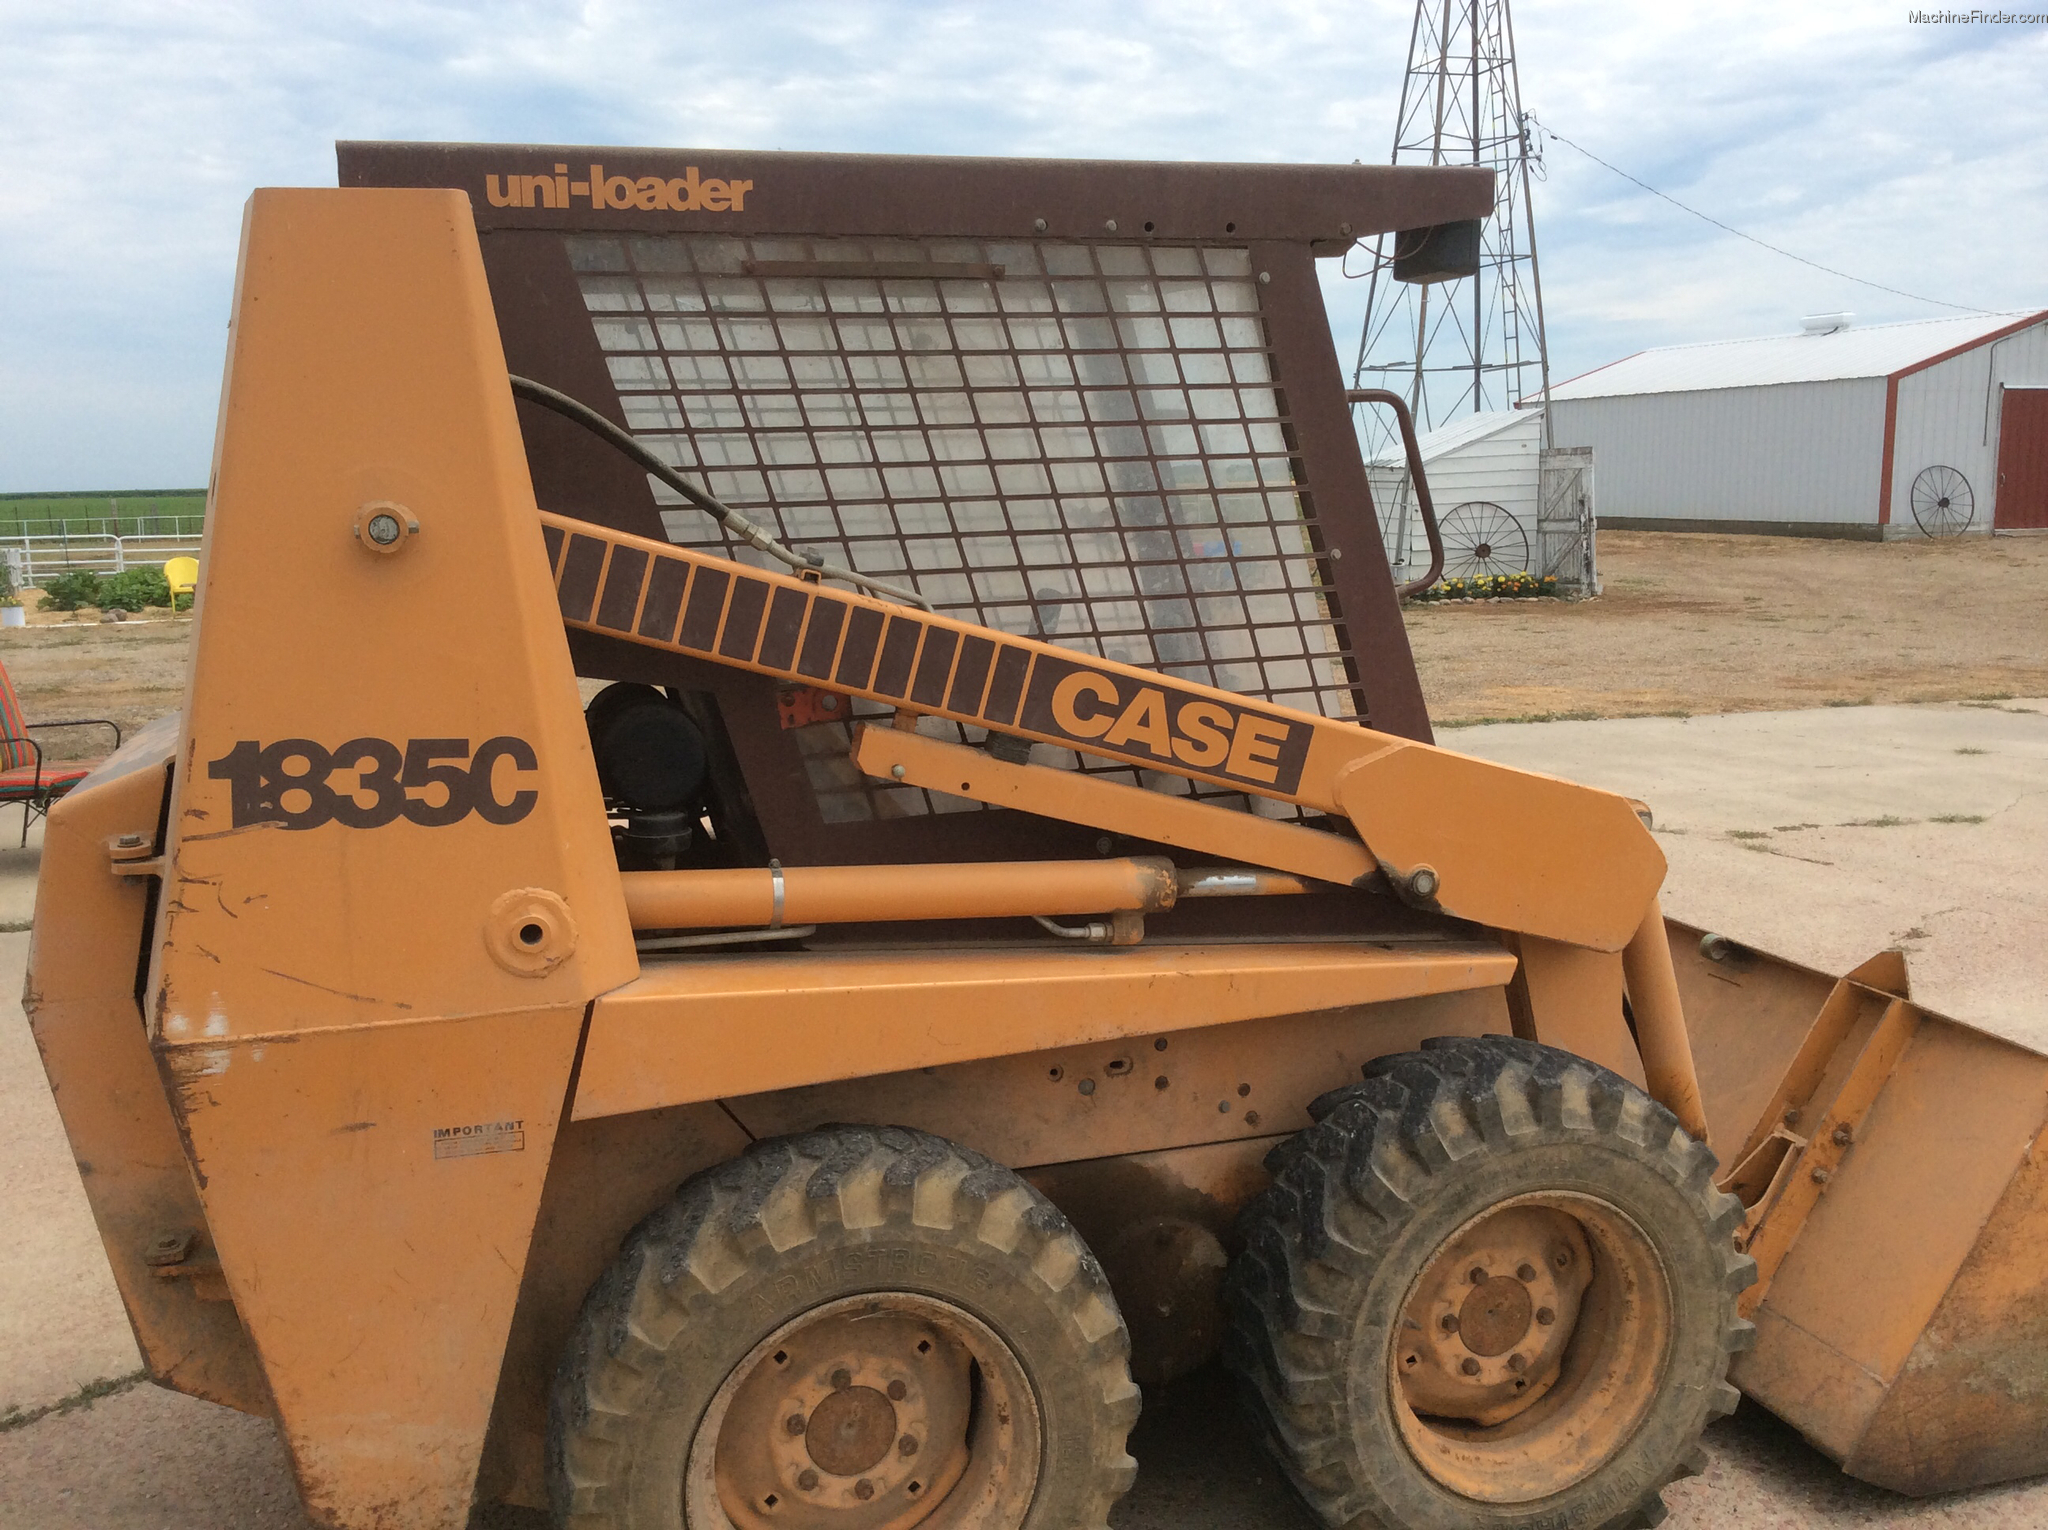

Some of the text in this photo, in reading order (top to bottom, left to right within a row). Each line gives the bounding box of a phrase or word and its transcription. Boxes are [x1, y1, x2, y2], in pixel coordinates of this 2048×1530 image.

[486, 163, 753, 212] uni-loader
[1052, 671, 1290, 784] CASE
[208, 736, 538, 830] 1835C
[433, 1120, 524, 1138] IMPORTANT
